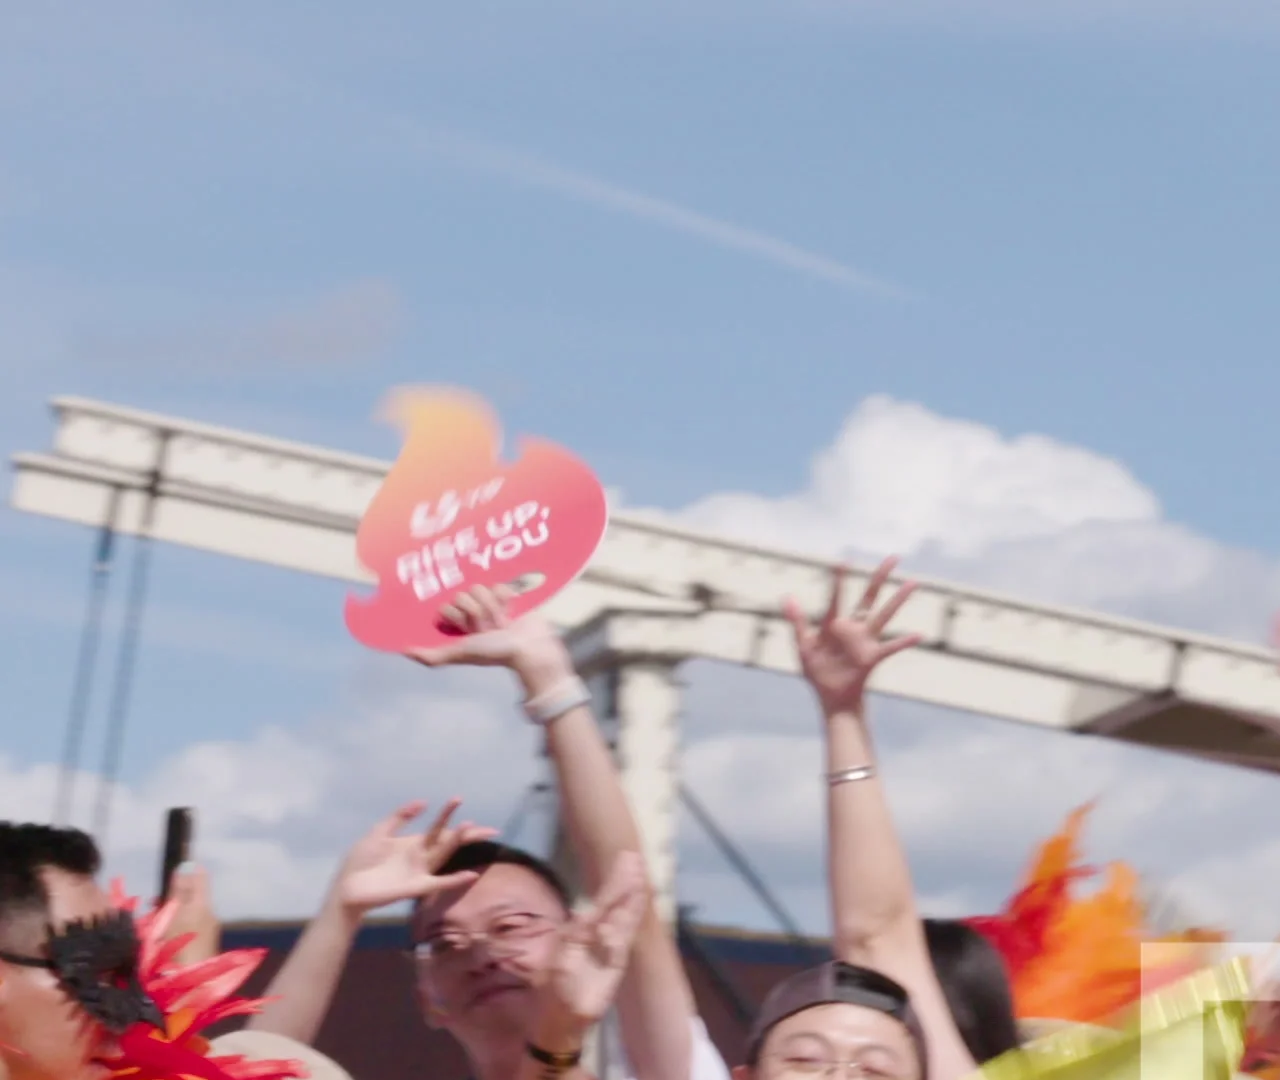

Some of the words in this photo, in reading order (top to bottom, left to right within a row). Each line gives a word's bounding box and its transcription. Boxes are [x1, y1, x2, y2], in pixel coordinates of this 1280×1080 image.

[397, 526, 479, 584] RISE
[411, 559, 465, 602] BE
[469, 520, 549, 571] YOU
